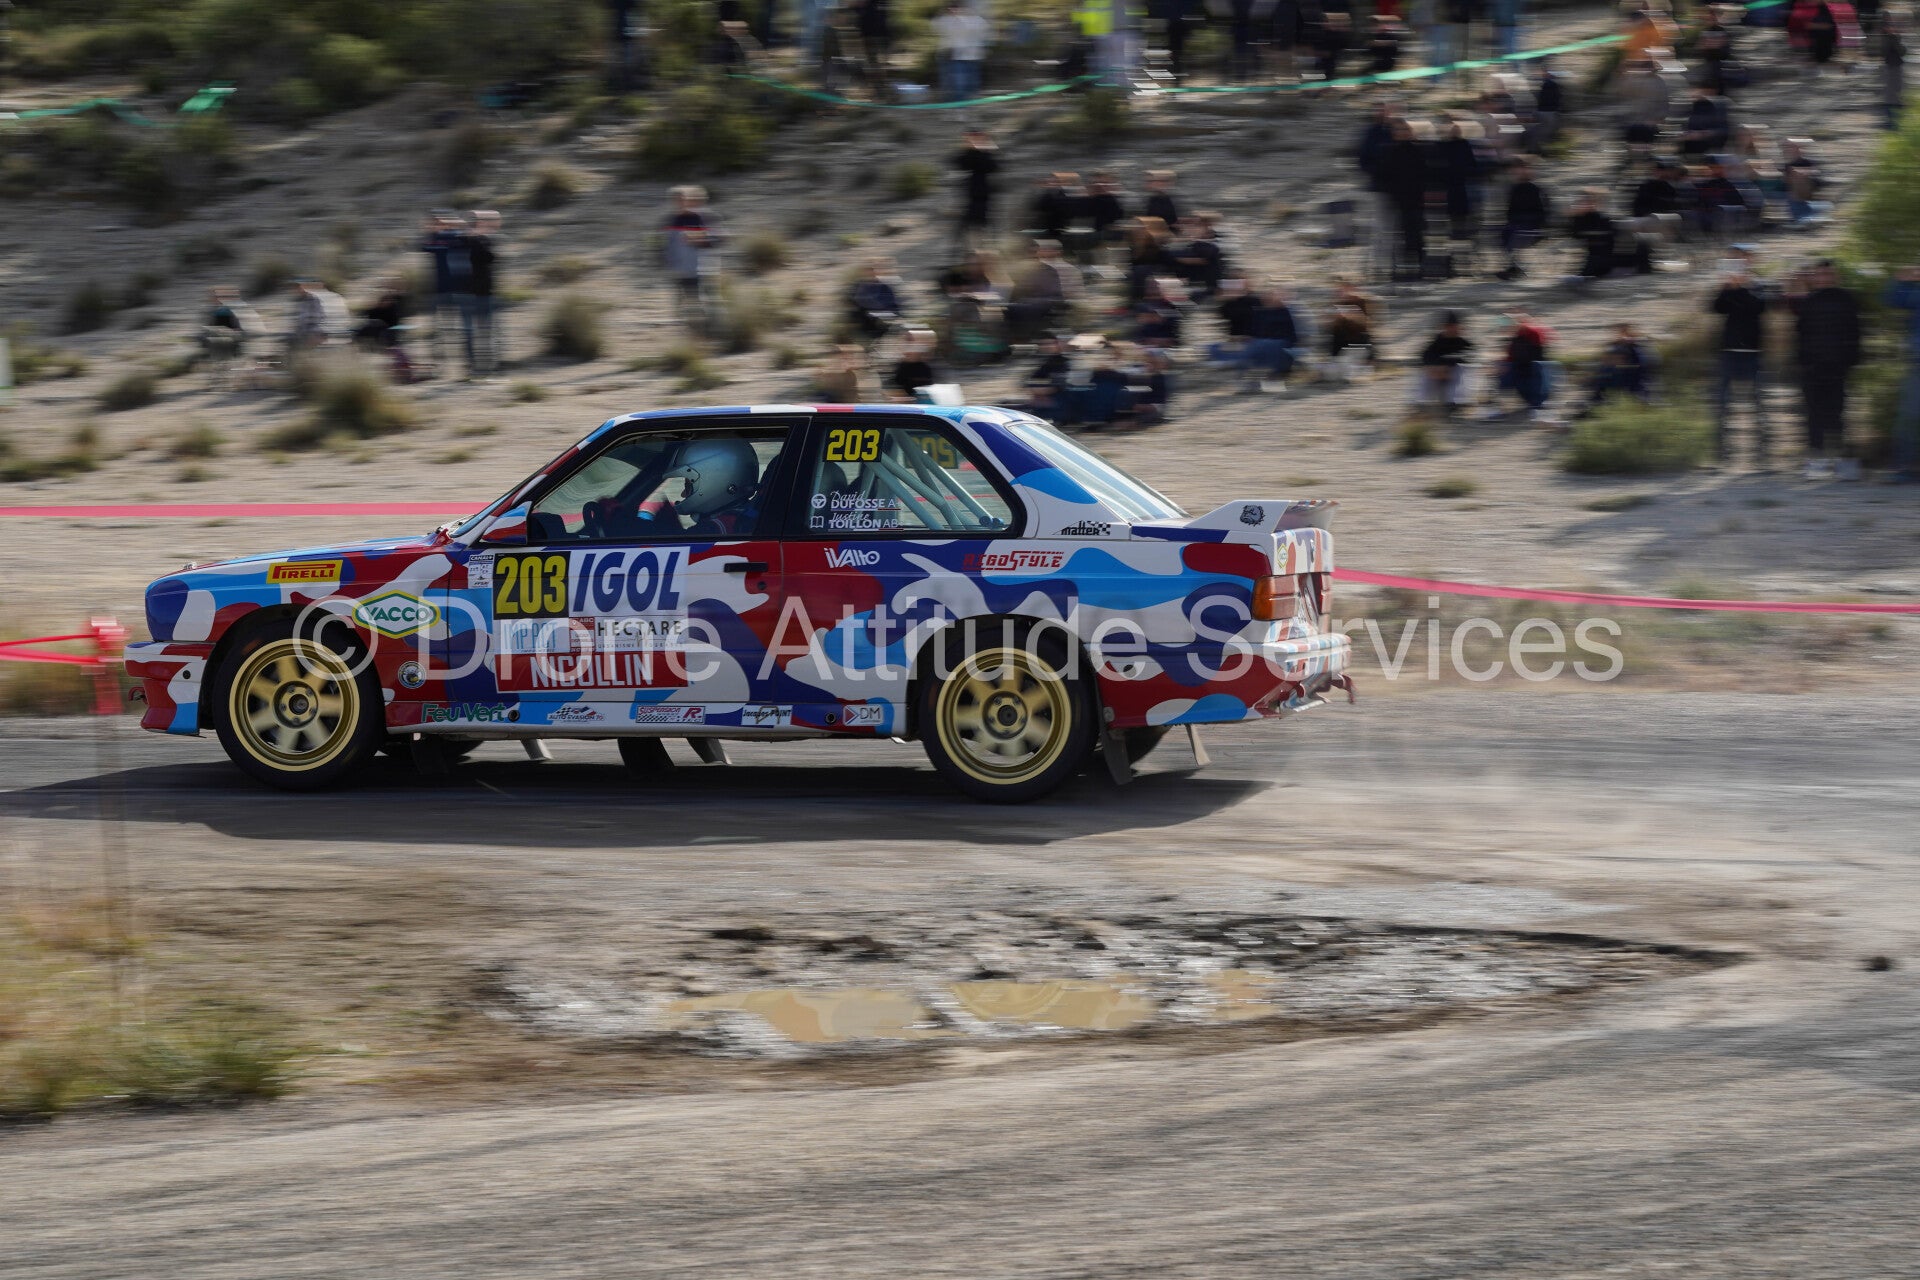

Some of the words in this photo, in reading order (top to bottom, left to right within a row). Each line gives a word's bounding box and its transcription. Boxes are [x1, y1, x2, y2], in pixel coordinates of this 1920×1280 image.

[826, 429, 880, 461] 203
[830, 490, 865, 501] David
[830, 499, 885, 509] DUFOSSE
[828, 519, 881, 529] TOILLON
[832, 511, 870, 521] Justine
[272, 563, 336, 580] PIRELLI
[495, 555, 567, 614] 203
[572, 550, 681, 613] IGOL
[364, 606, 429, 622] YACCO
[597, 620, 683, 637] HECTARE
[530, 654, 652, 688] NICOLLIN
[422, 703, 460, 723] Feu
[463, 702, 506, 723] Vert
[860, 707, 880, 719] DM
